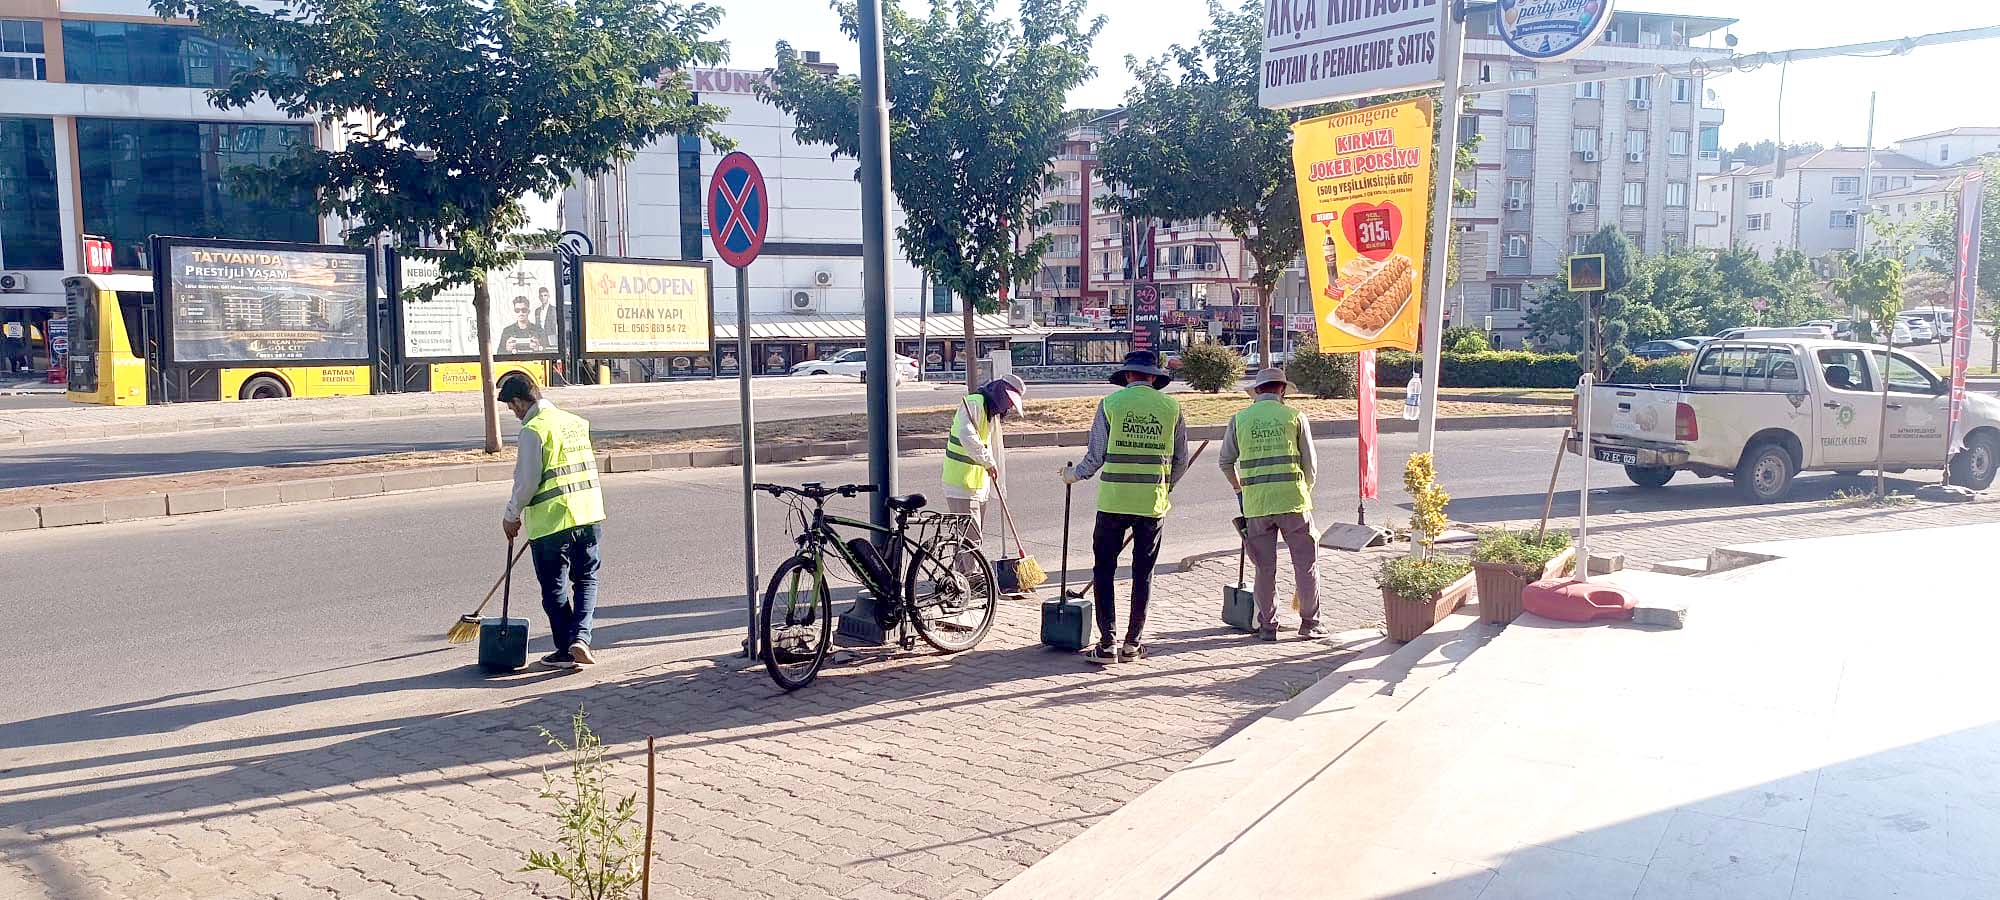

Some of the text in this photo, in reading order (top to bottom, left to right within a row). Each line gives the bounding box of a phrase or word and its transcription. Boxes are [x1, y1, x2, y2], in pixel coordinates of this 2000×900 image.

[1327, 0, 1436, 25] KIRTA
[1516, 2, 1555, 24] party
[1265, 30, 1436, 88] TOPTAN & PERAKENDE SATIŞ
[1336, 128, 1394, 154] KIRMIZI
[1310, 159, 1353, 181] JOKER
[1359, 221, 1385, 243] 315
[246, 267, 288, 280] YAŞAM
[618, 276, 694, 295] ADOPEN
[617, 305, 683, 320] ÖZHAN YAPI
[1122, 422, 1163, 435] BATMAN
[1251, 427, 1286, 439] BATMAN
[1602, 452, 1610, 461] 72
[1623, 454, 1636, 464] 029
